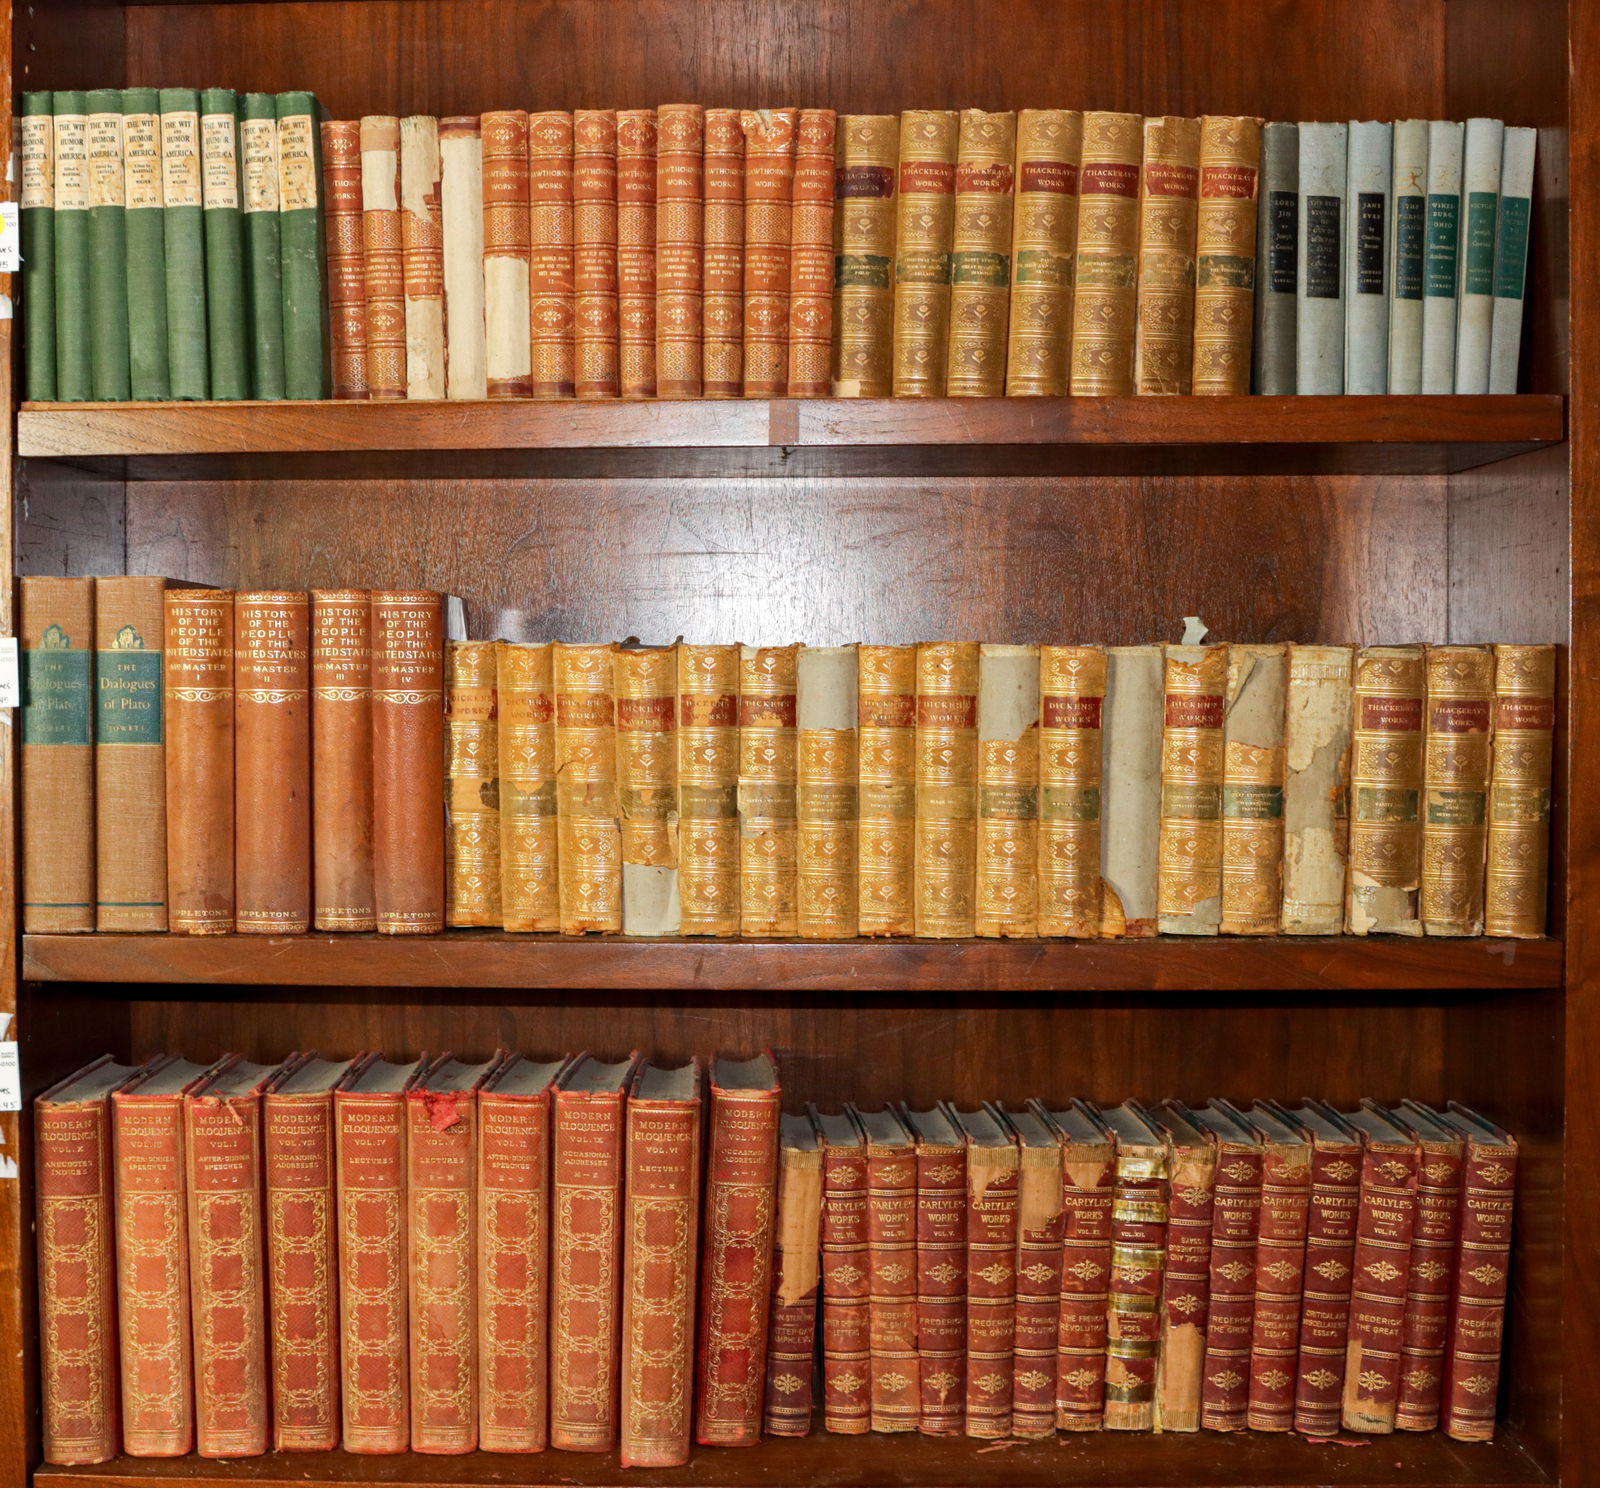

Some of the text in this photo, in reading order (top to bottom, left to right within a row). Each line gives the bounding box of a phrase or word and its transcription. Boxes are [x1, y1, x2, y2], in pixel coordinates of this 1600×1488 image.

[165, 120, 191, 129] THE WIT
[166, 135, 190, 143] HUMOR
[281, 136, 304, 144] HUMOR
[165, 150, 194, 158] AMERICA
[281, 151, 308, 159] AMERICA
[1099, 181, 1125, 189] WORKS
[172, 608, 225, 616] HISTORY
[242, 610, 296, 619] HISTORY
[315, 608, 367, 616] HISTORY
[379, 611, 432, 619] HISTORY
[178, 618, 219, 626] OF THE
[248, 620, 289, 628] OF THE
[321, 618, 361, 626] OF THE
[386, 620, 427, 628] OF THE
[170, 628, 224, 636] PEOPLE
[241, 630, 296, 639] PEOPLE
[314, 628, 366, 636] PEOPLE
[378, 630, 432, 639] PEOPLE
[178, 638, 218, 646] OF THE
[248, 640, 289, 648] OF THE
[321, 638, 360, 646] OF THE
[386, 640, 427, 648] OF THE
[267, 650, 306, 659] STATES
[100, 677, 156, 691] Dialogues
[104, 697, 151, 709] of Plato
[273, 1114, 320, 1123] MODERN
[348, 1114, 394, 1123] MODERN
[563, 1111, 612, 1120] MODERN
[725, 1110, 771, 1118] MODERN
[43, 1120, 93, 1129] MODERN
[124, 1116, 171, 1125] MODERN
[271, 1125, 326, 1134] ELOQUENCE
[343, 1125, 400, 1134] ELOQUENCE
[559, 1122, 616, 1132] ELOQUENCE
[639, 1121, 688, 1130] MODERN
[40, 1132, 97, 1141] ELOQUENCE
[919, 1201, 966, 1210] CARLYLE'S
[972, 1201, 1016, 1210] CARLYLE'S
[1065, 1197, 1112, 1207] CARLYLE'S
[1312, 1195, 1358, 1207] CARLYLE'S
[1364, 1195, 1412, 1209] CARLYLE'S
[878, 1214, 909, 1223] WORKS
[927, 1213, 959, 1222] WORKS
[981, 1214, 1011, 1223] WORKS
[1074, 1210, 1103, 1220] WORKS
[1223, 1211, 1252, 1220] WORKS
[1321, 1209, 1350, 1219] WORKS
[1371, 1209, 1404, 1222] WORKS
[1476, 1213, 1506, 1223] WORKS
[829, 1215, 860, 1224] WORKS
[1355, 1312, 1402, 1326] FREDERICK
[1356, 1323, 1399, 1335] THE GREAT
